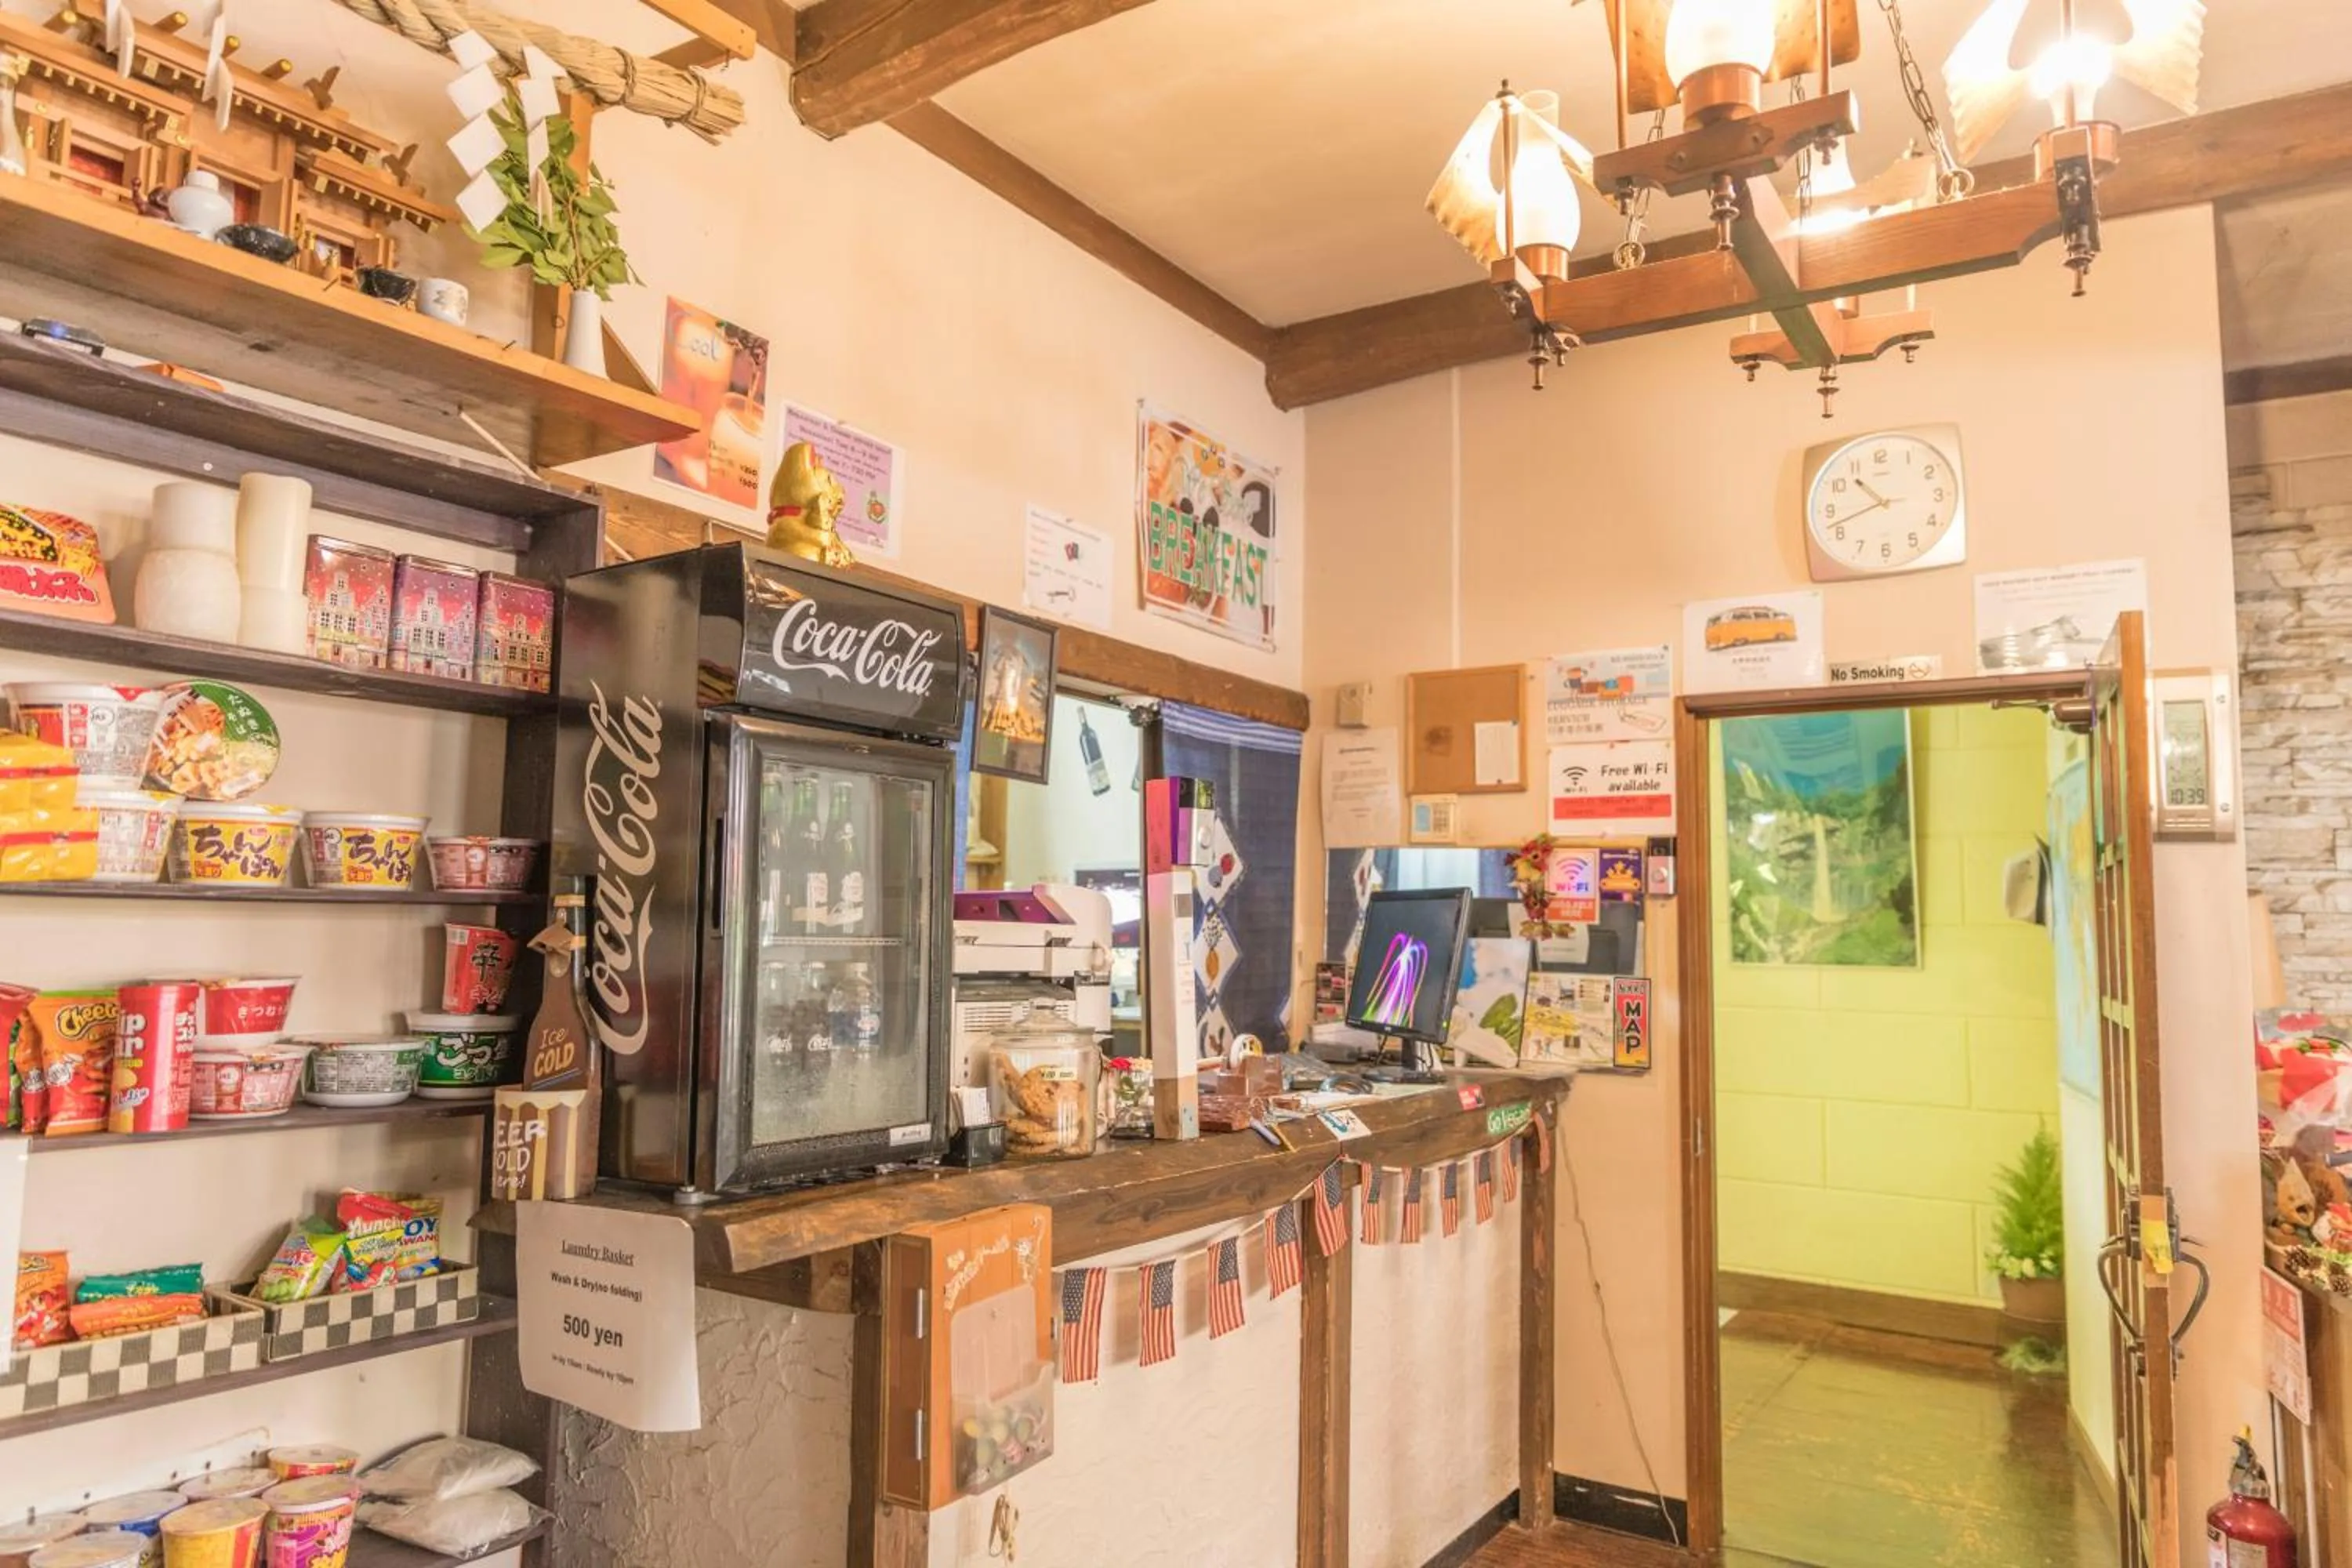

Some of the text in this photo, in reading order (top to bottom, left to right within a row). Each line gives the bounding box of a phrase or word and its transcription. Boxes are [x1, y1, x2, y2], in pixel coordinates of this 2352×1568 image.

[1874, 449, 1888, 463] 12
[1907, 450, 1911, 465] 1
[1850, 459, 1860, 475] 11
[1924, 465, 1935, 480] 2
[1831, 478, 1846, 493] 10
[1933, 488, 1944, 503] 3
[1826, 503, 1835, 519] 9
[1926, 514, 1936, 527] 4
[1835, 526, 1845, 540] 8
[1907, 532, 1918, 547] 5
[1150, 501, 1267, 607] BREAKFAST
[1856, 539, 1865, 554] 7
[1881, 543, 1892, 557] 6
[772, 598, 943, 697] Coca-Cola
[1831, 666, 1904, 681] No Smoking
[1600, 764, 1630, 777] Free
[1608, 779, 1661, 793] available
[584, 679, 663, 1055] Coca-Cola
[59, 1004, 120, 1038] Cheeto
[1624, 1000, 1642, 1054] MAP
[539, 1028, 567, 1050] Ice
[534, 1042, 575, 1077] COLD
[495, 1119, 546, 1148] EER
[495, 1147, 531, 1172] OLD
[497, 1174, 527, 1189] ere!
[347, 1216, 405, 1240] Munch
[405, 1218, 437, 1236] OY
[561, 1239, 634, 1266] Laundry Basket
[551, 1272, 572, 1285] Wash
[573, 1276, 579, 1287] &
[563, 1314, 622, 1348] 500 yen
